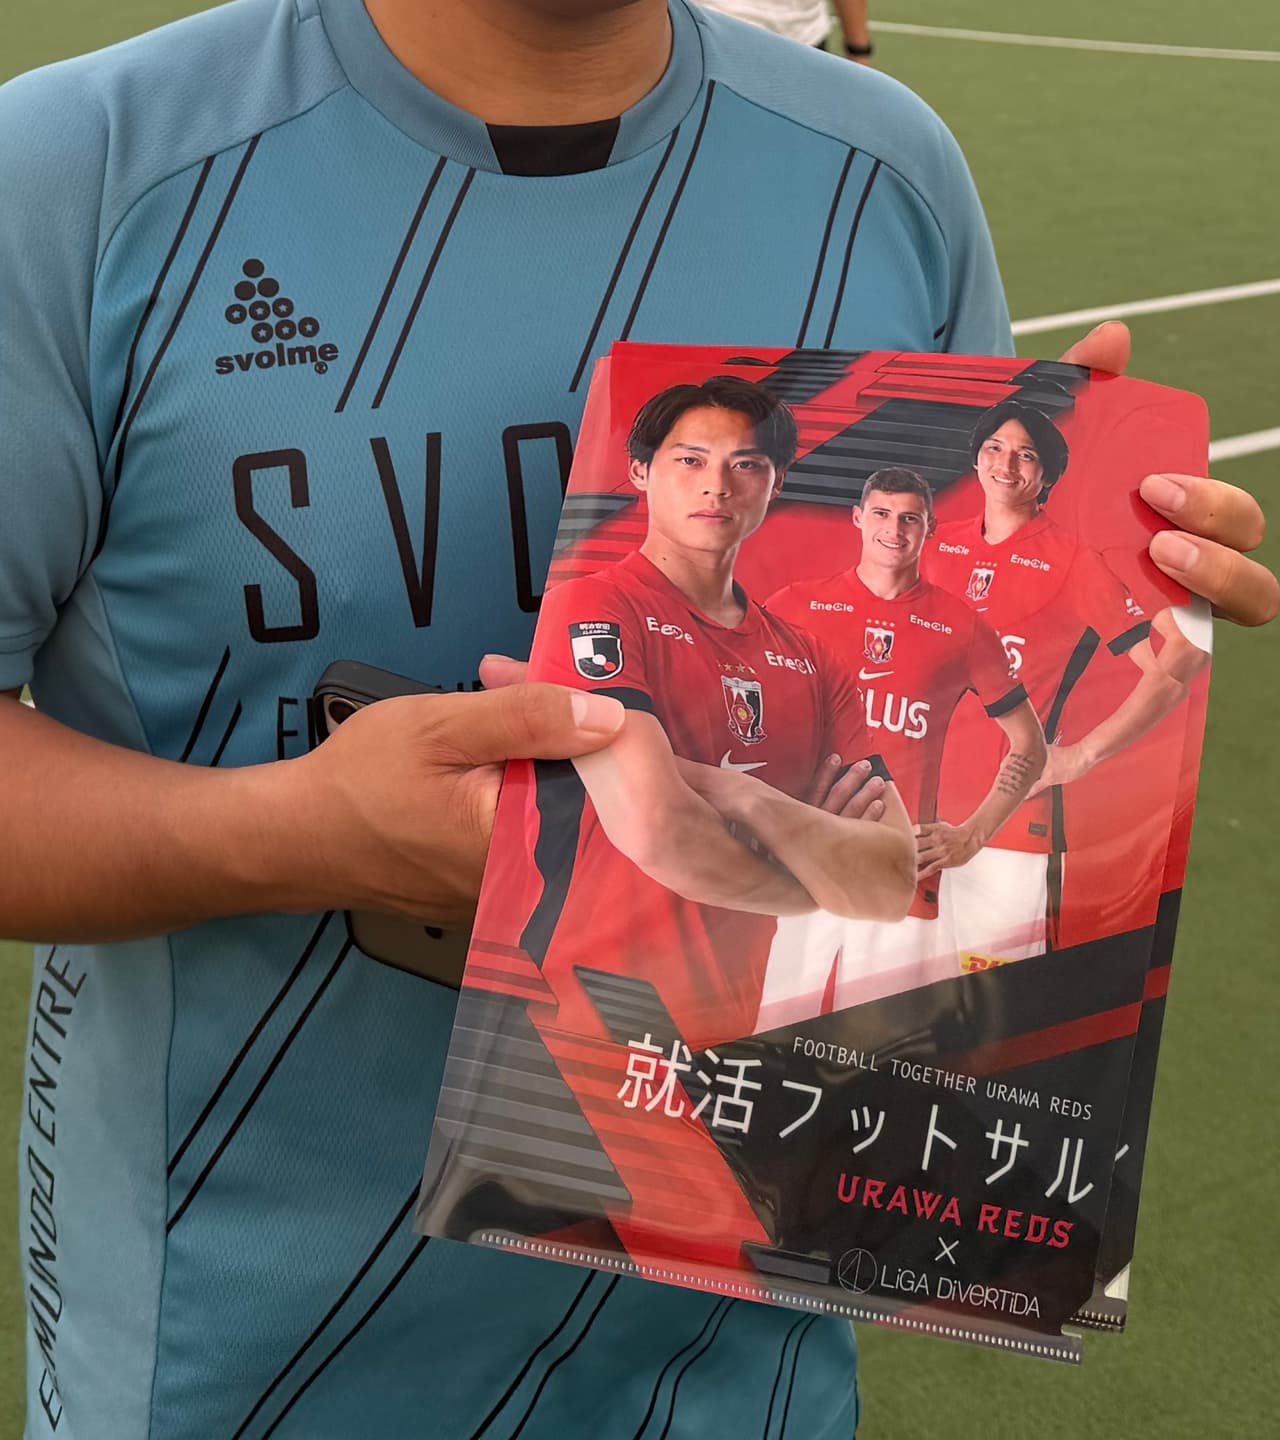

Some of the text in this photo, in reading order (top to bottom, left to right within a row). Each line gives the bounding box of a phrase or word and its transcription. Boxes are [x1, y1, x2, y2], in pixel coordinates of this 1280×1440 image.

[215, 342, 339, 375] svolme
[857, 687, 931, 740] LUS
[28, 944, 88, 1147] ENTRE
[793, 1036, 1093, 1121] FOOTBALL TOGETHER URAWA REDS
[616, 1032, 1095, 1204] 就活フットサル
[836, 1172, 1076, 1249] URAWA REDS
[27, 1144, 63, 1371] MUNDO
